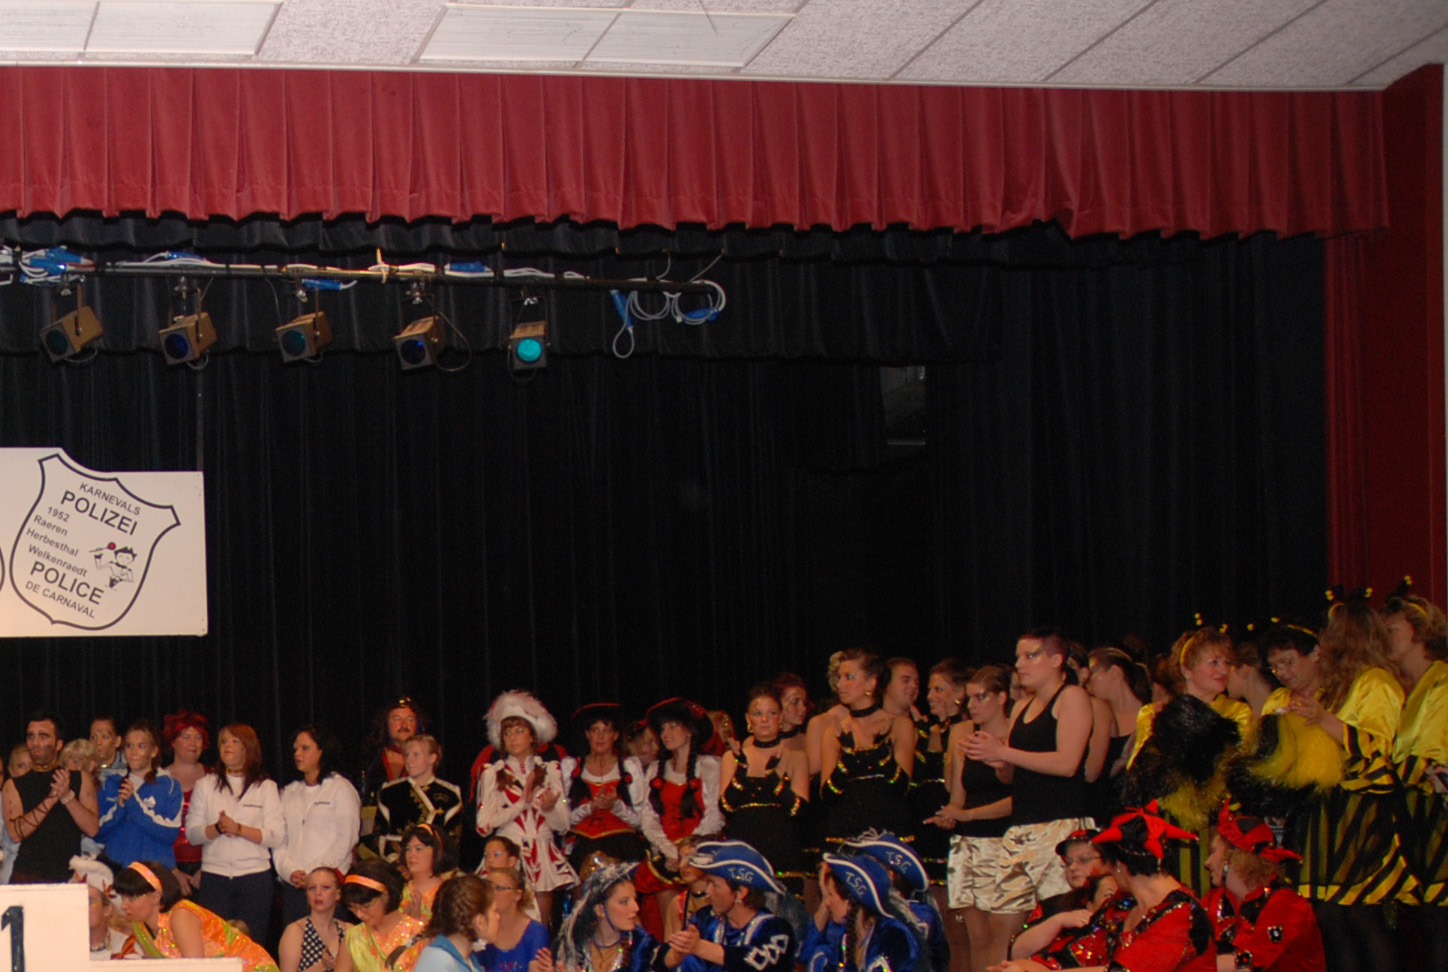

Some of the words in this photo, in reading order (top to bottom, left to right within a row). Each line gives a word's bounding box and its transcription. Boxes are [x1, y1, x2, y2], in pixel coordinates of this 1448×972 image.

[48, 506, 70, 523] 1952
[60, 490, 138, 536] POLIZEI
[80, 482, 141, 516] KARNEVALS
[33, 514, 68, 536] Raeren
[26, 527, 79, 557] Herbesthal
[28, 544, 87, 577] Welkenraedt
[25, 580, 41, 593] DE
[42, 588, 95, 618] CARNAVAL
[30, 560, 105, 605] POLICE
